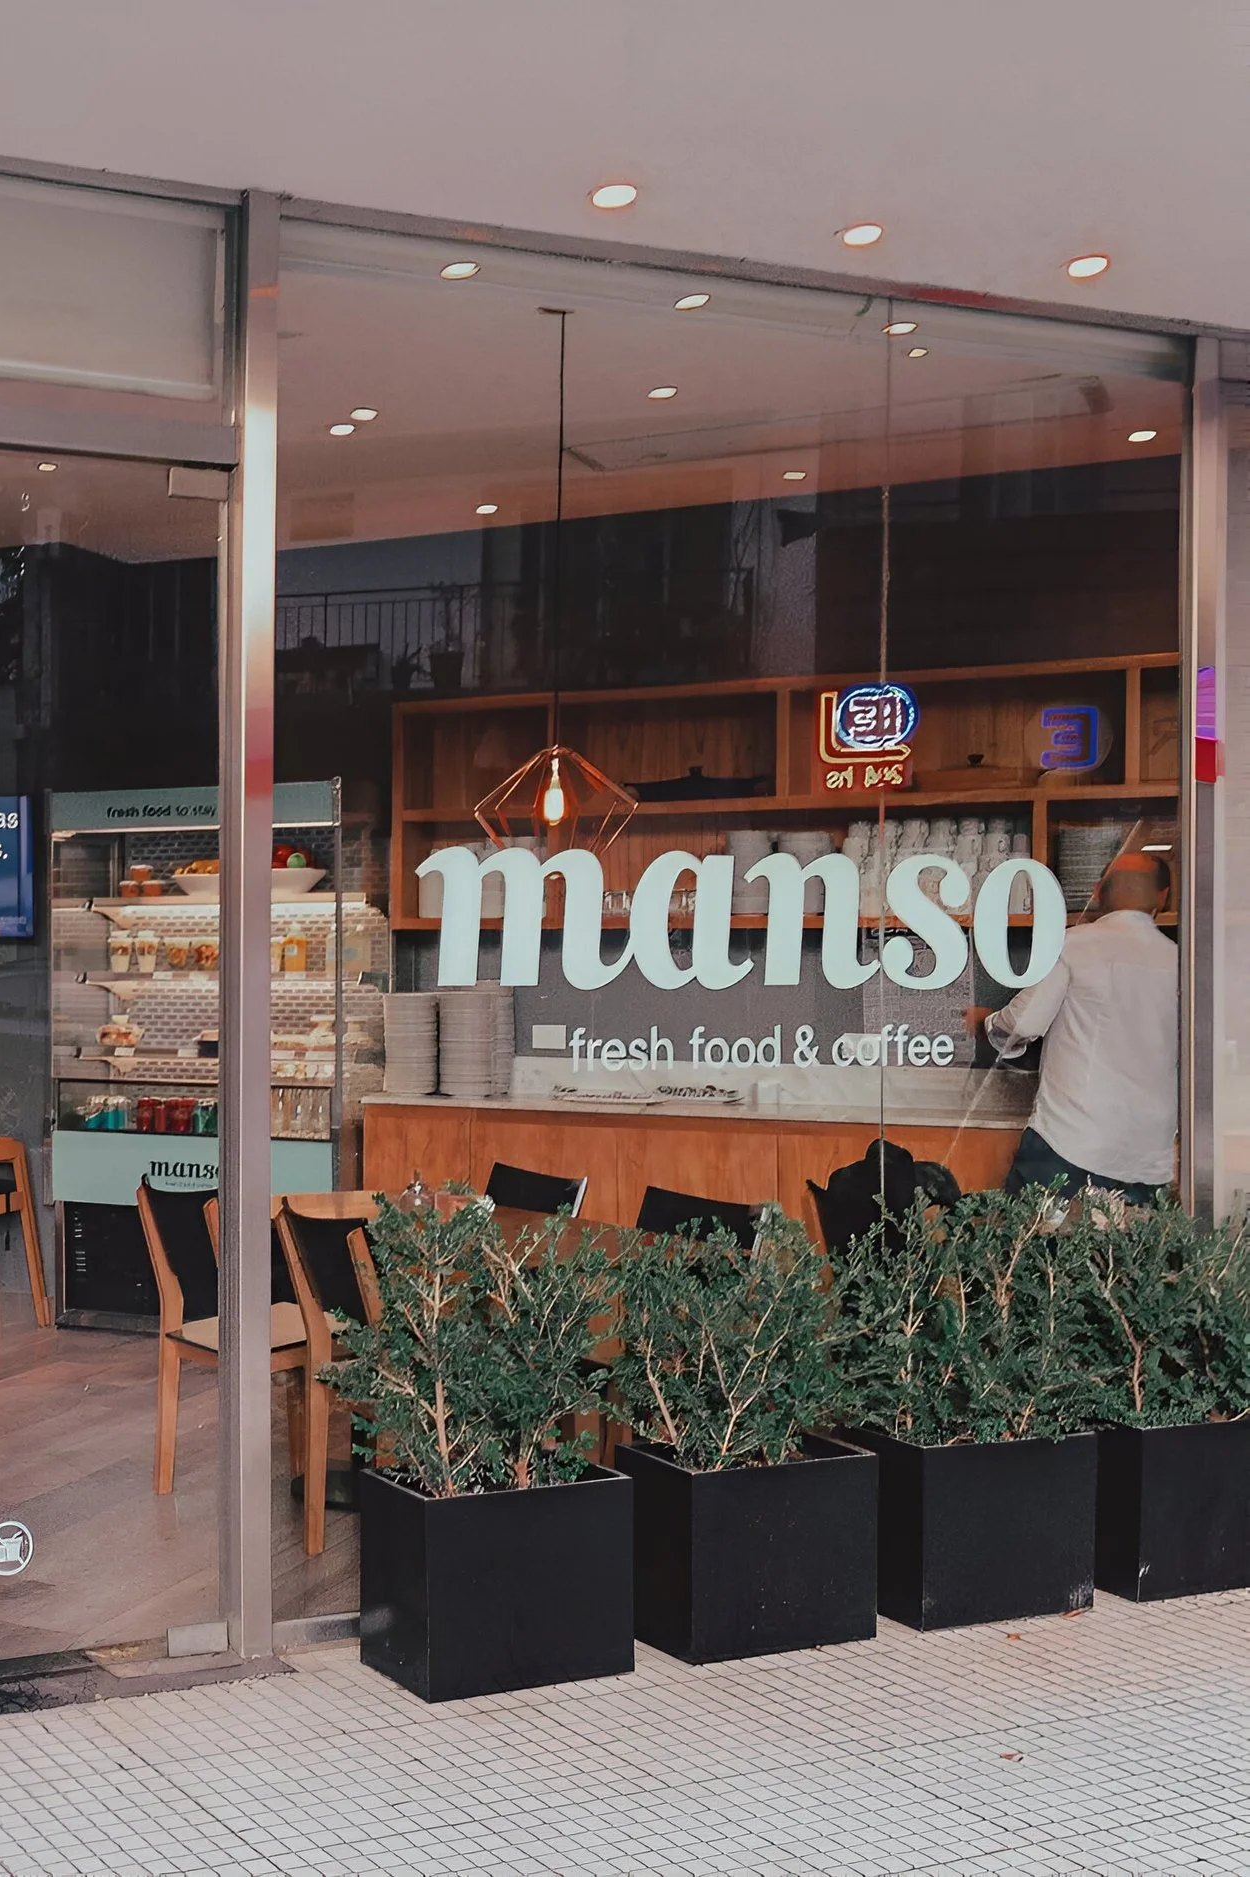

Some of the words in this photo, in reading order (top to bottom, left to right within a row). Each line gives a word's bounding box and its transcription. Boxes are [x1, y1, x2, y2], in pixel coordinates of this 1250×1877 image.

[415, 845, 1067, 991] manso
[568, 1026, 675, 1073] fresh
[688, 1025, 782, 1069] food
[793, 1024, 821, 1068] &
[831, 1023, 955, 1067] coffee
